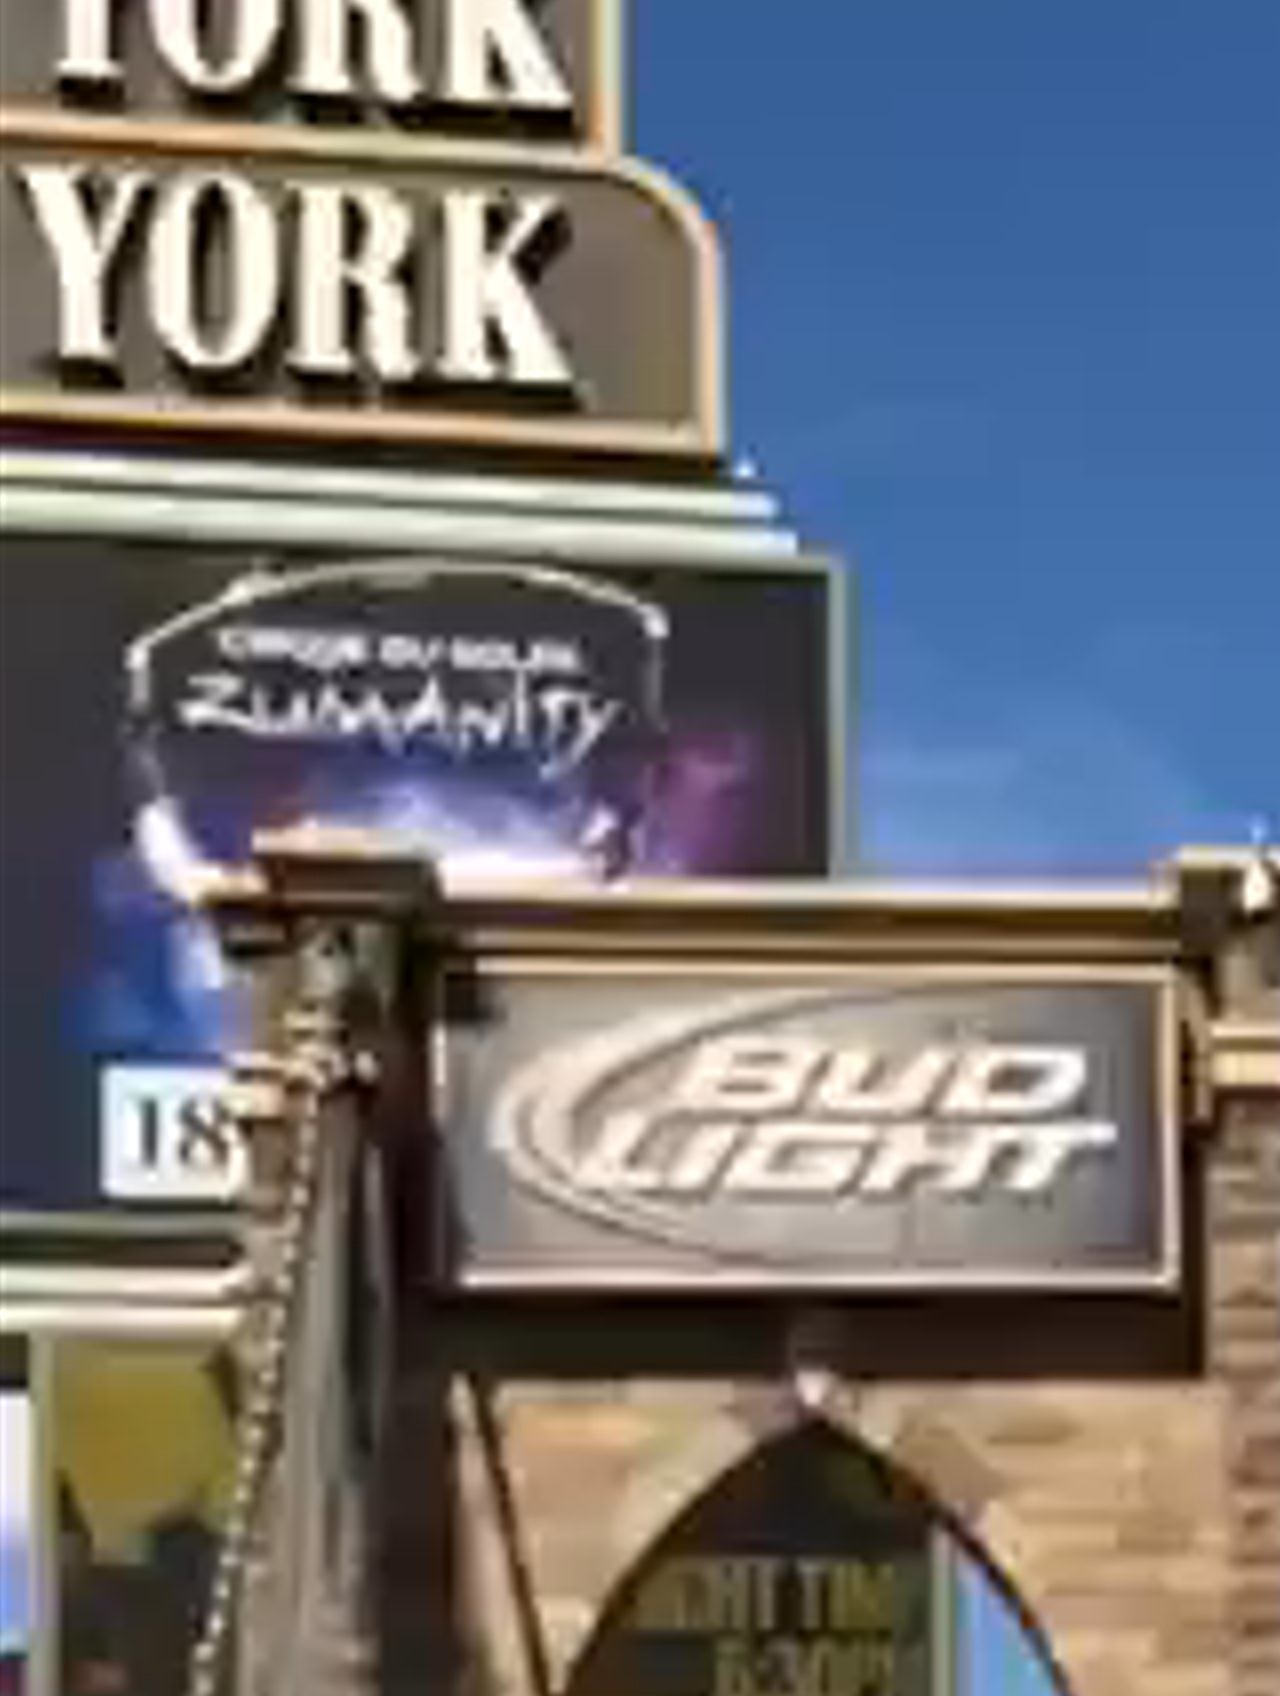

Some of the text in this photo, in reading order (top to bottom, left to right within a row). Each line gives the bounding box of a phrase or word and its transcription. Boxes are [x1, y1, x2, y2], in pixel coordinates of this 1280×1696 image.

[18, 162, 576, 383] YORK
[676, 1034, 1088, 1116] BUD
[574, 1110, 1120, 1194] LIGHT
